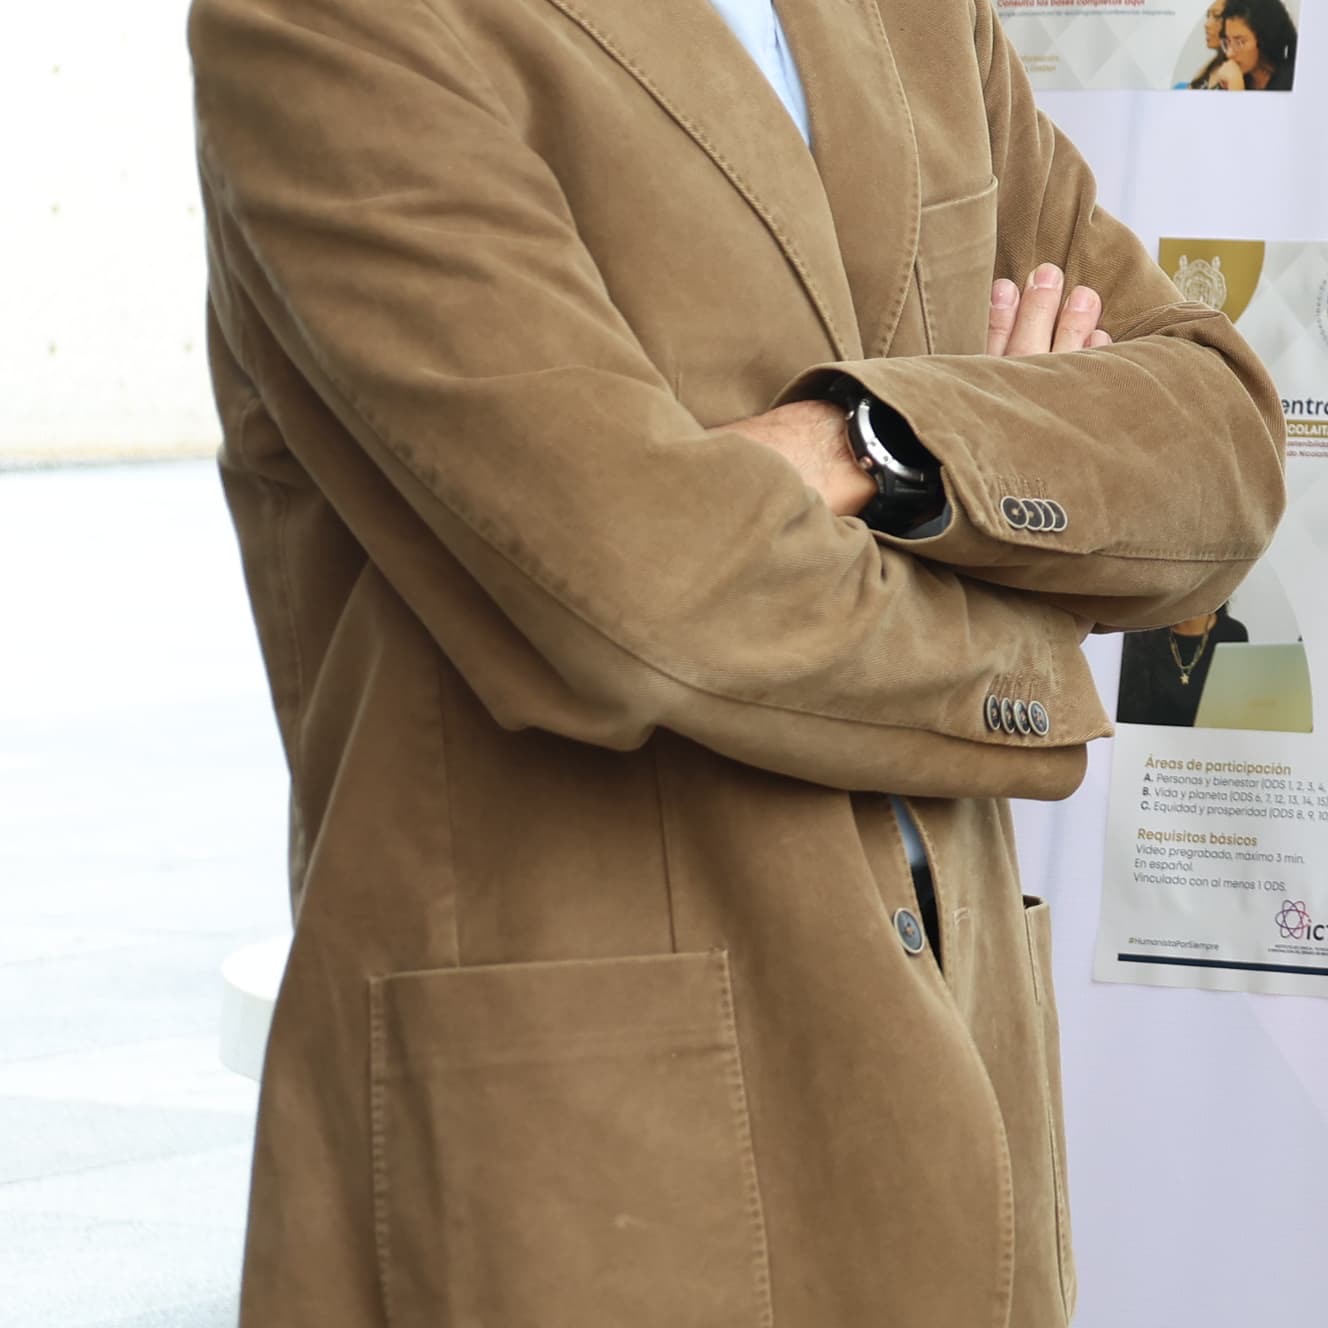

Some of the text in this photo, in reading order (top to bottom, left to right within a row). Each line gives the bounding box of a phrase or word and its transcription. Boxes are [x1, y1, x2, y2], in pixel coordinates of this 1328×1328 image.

[1145, 755, 1291, 777] Áreas de participación
[1138, 828, 1258, 847] Requisitos básicos
